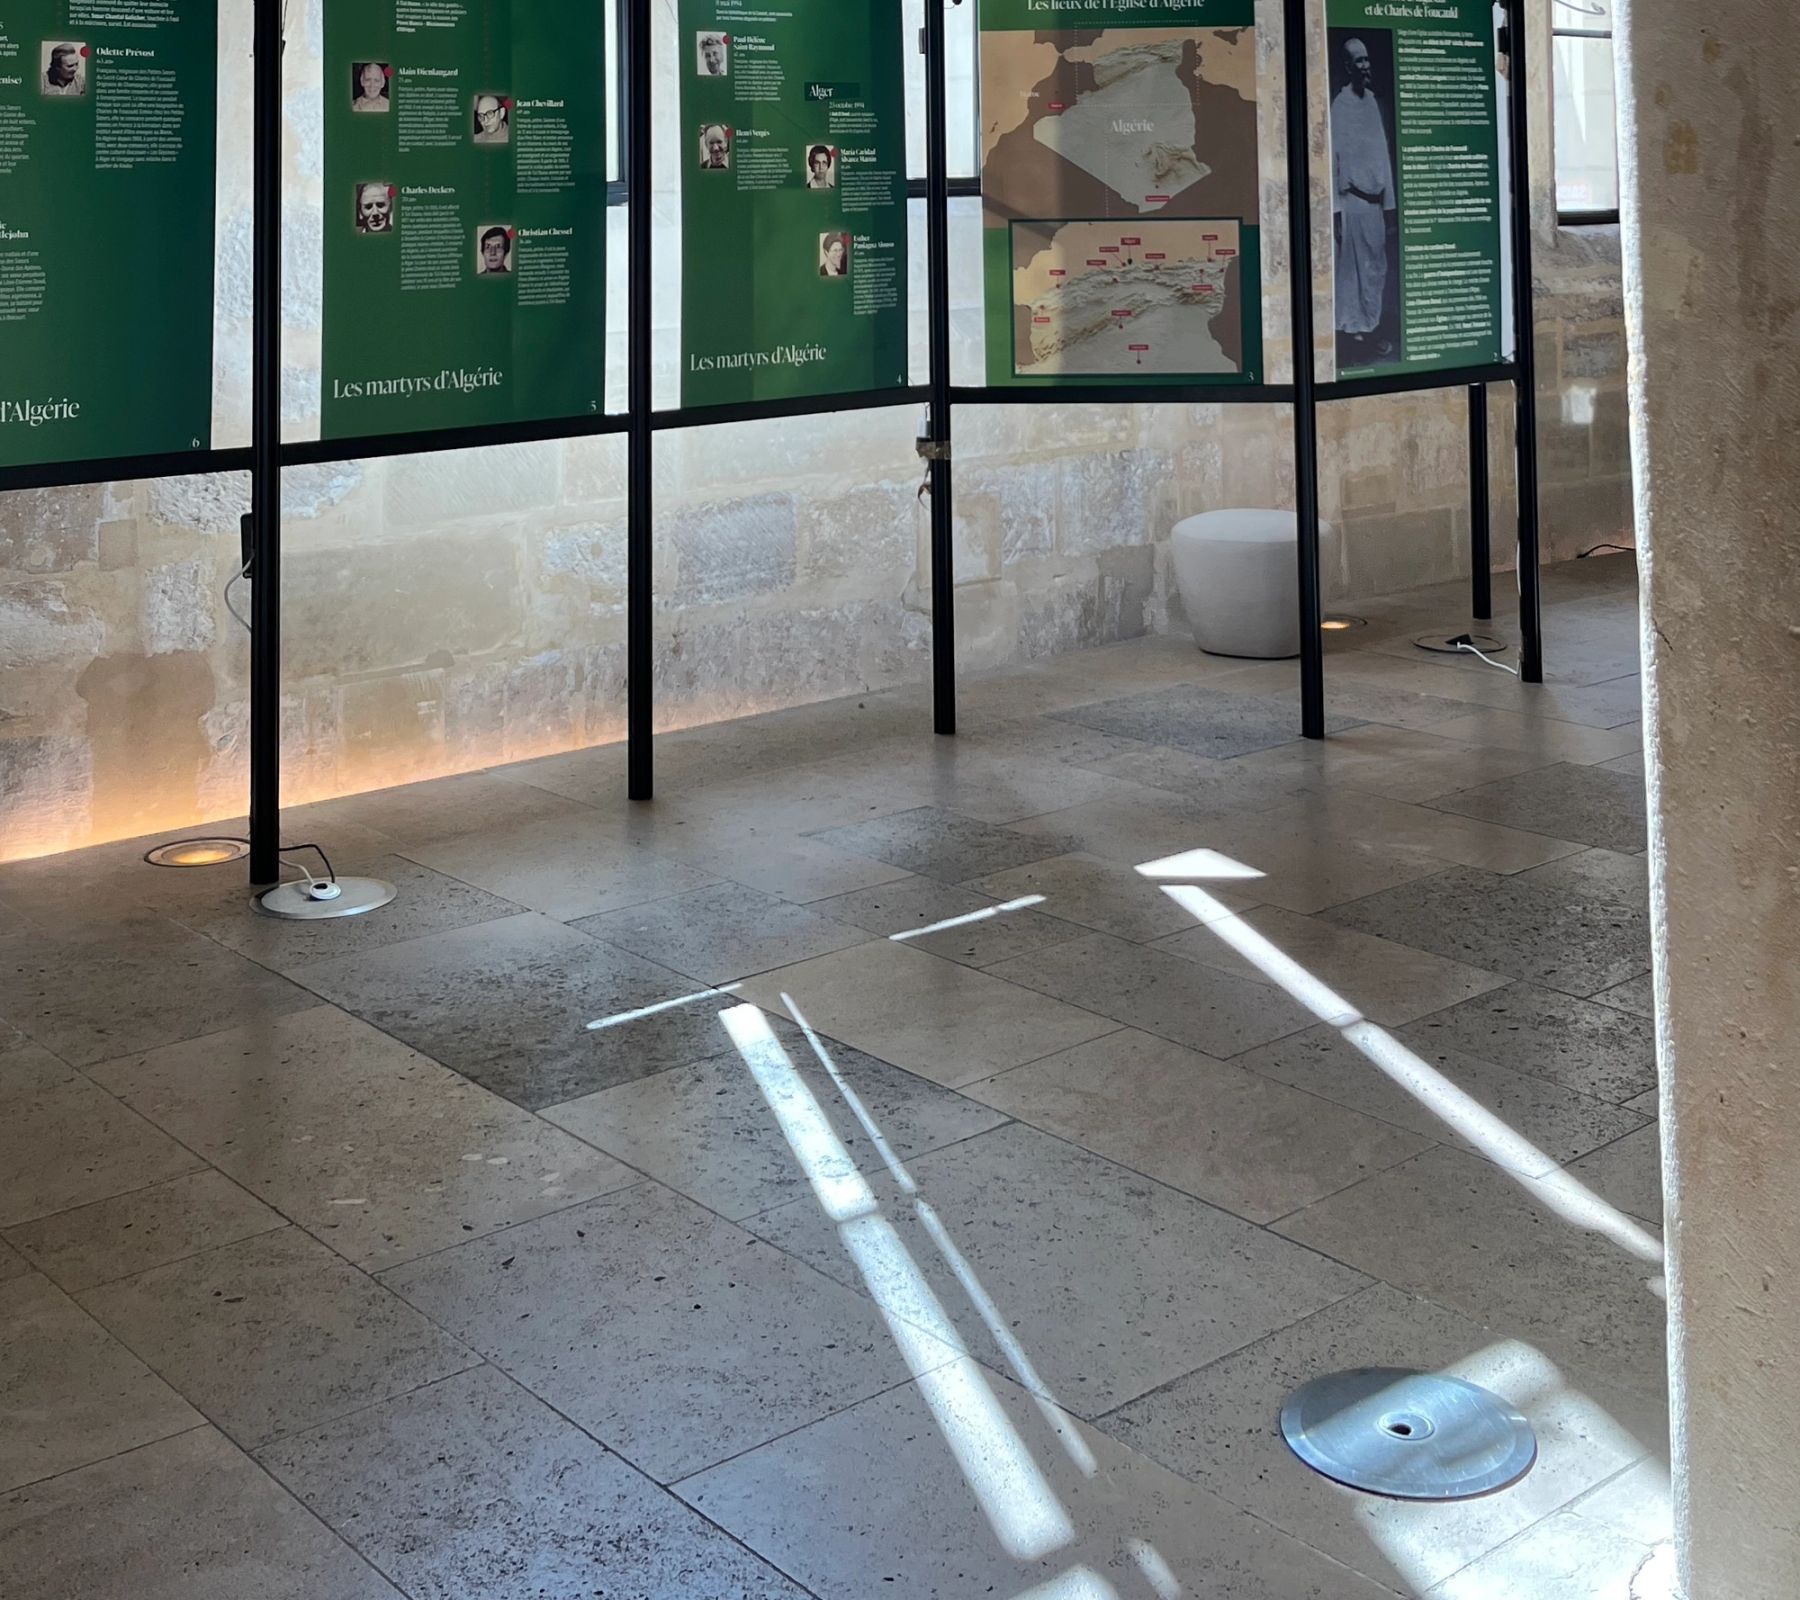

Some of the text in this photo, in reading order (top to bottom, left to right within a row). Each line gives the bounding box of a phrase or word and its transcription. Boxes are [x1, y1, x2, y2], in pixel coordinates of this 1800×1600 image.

[1364, 4, 1372, 15] et
[1373, 3, 1384, 16] de
[1384, 3, 1413, 17] Charles
[1413, 4, 1423, 18] de
[96, 47, 155, 57] Odette Prévost
[809, 84, 834, 100] Alger
[1110, 118, 1155, 134] Algérie
[690, 343, 827, 371] Les martyrs d'Algérie
[334, 367, 503, 399] Les martyrs d'Algérie
[591, 400, 598, 412] 5
[192, 437, 201, 448] 6
